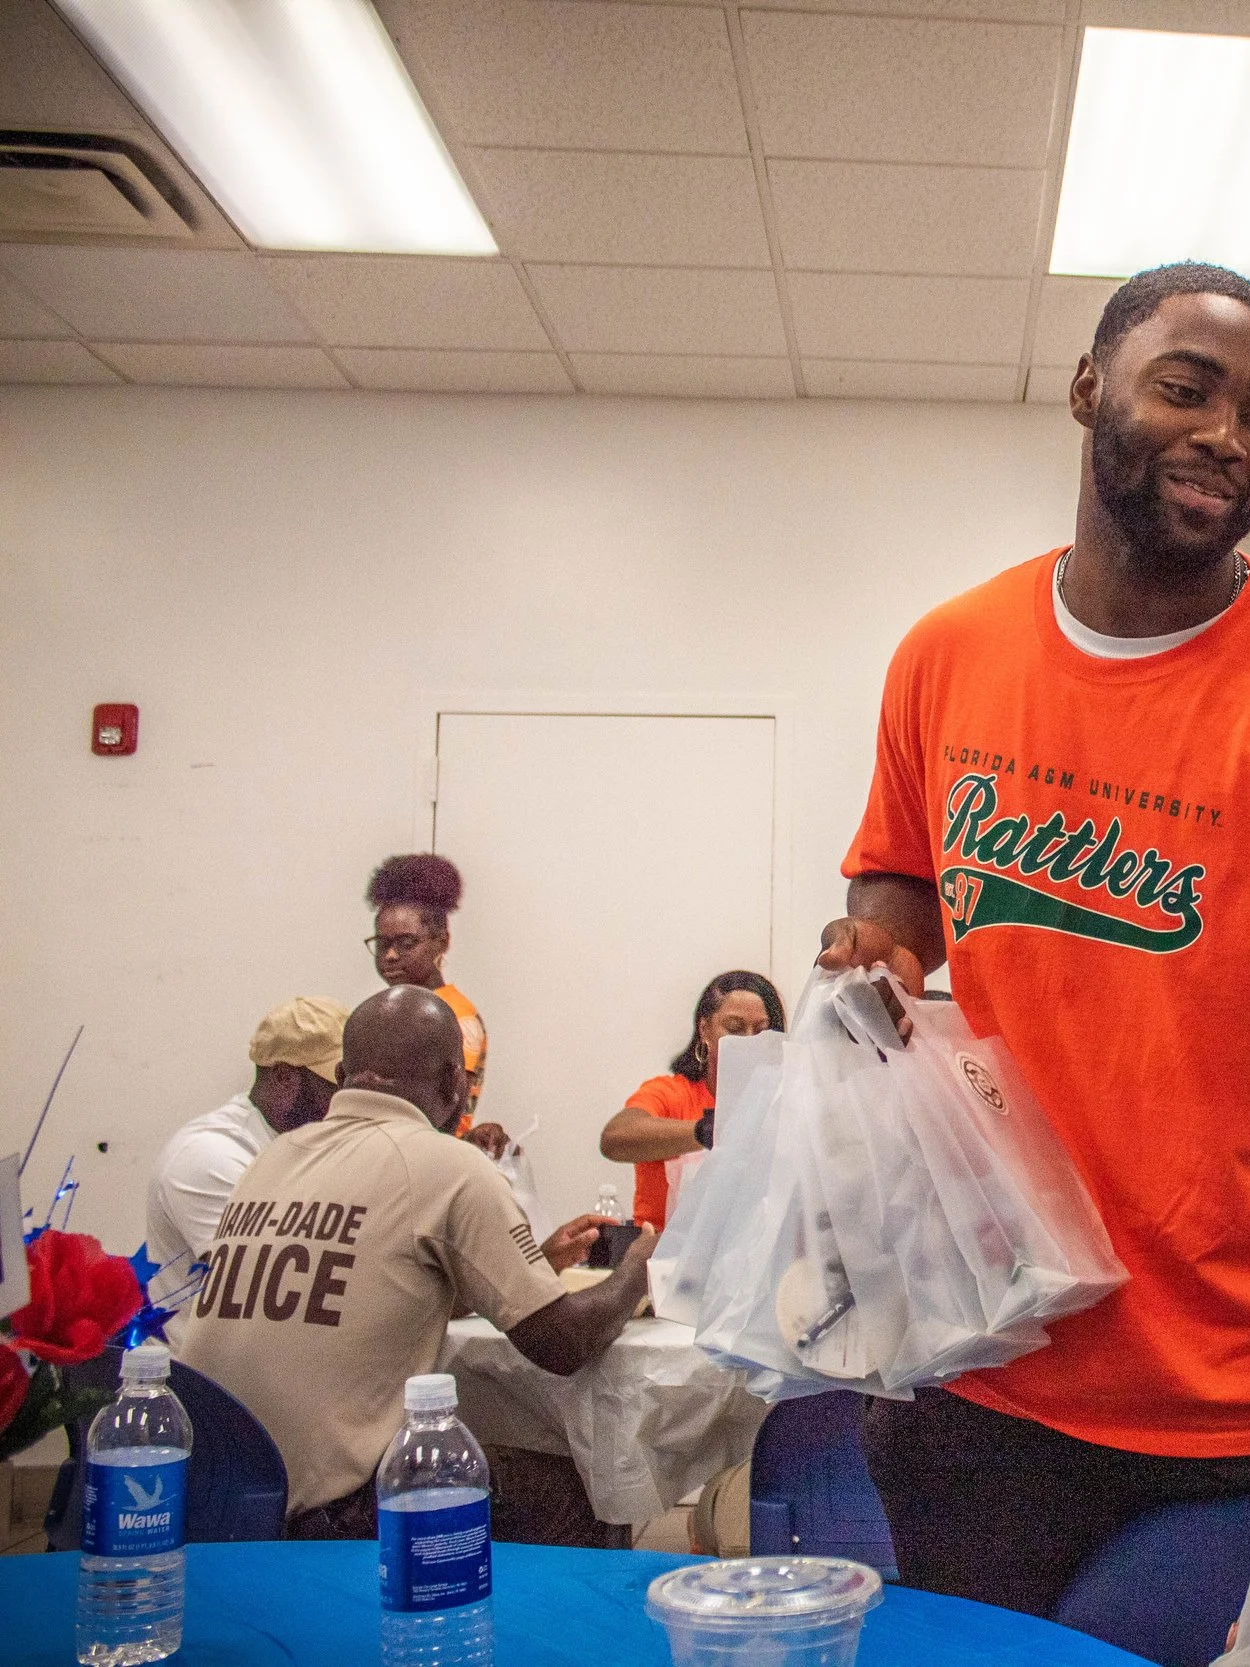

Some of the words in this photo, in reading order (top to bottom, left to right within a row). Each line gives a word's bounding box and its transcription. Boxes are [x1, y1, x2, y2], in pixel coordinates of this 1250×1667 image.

[944, 745, 1015, 775] FLORIDA
[943, 772, 1206, 916] Rattlers
[953, 872, 984, 926] 87
[213, 1201, 367, 1246] IAMI-DADE
[118, 1511, 171, 1530] Wawa
